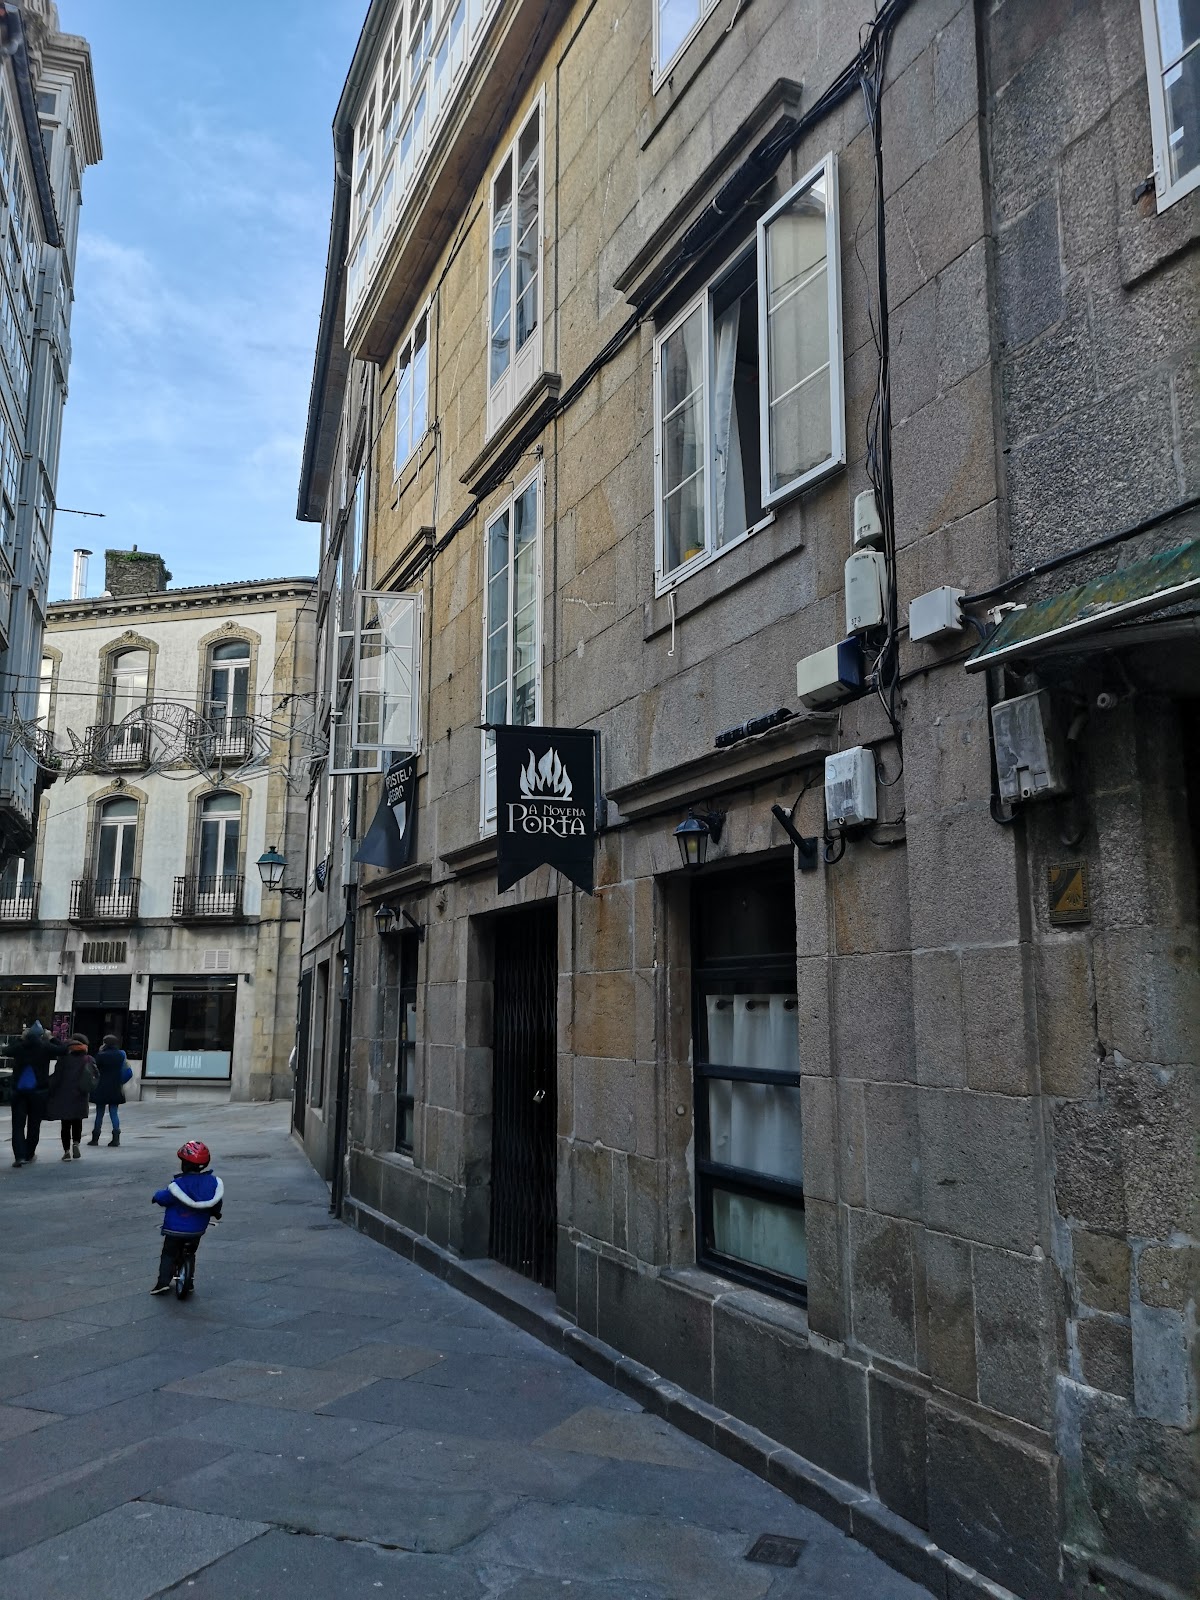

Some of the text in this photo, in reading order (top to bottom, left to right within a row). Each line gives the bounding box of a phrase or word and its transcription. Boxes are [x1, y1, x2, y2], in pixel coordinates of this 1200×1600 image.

[505, 803, 587, 838] PORTA
[528, 804, 586, 817] A NOVENA
[81, 942, 127, 964] MAMBARA
